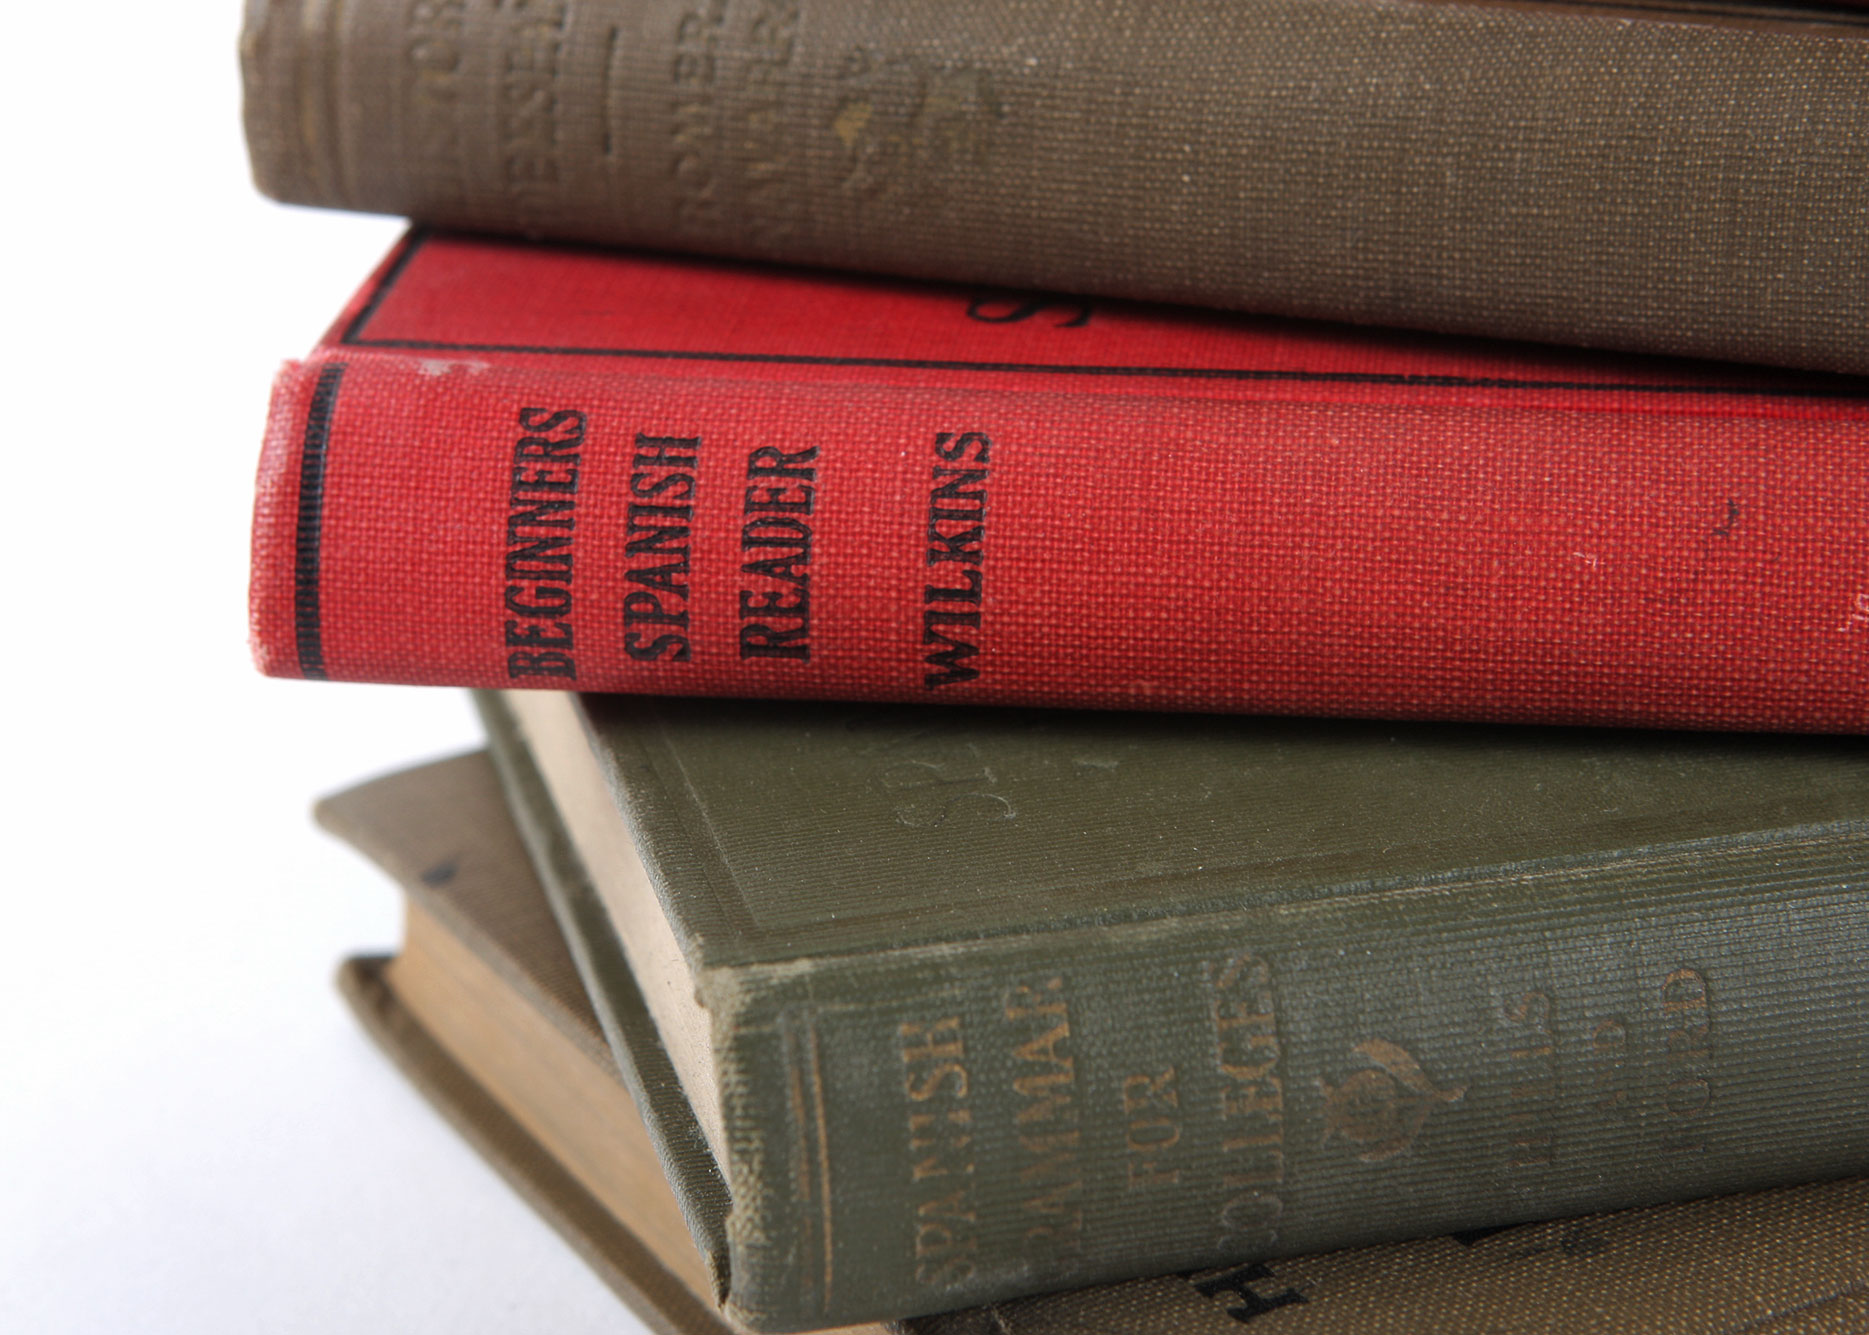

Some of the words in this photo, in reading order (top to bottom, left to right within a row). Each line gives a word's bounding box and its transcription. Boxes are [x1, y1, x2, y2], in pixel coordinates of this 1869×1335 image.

[504, 407, 587, 681] BEGINNERS
[623, 432, 701, 663] SPANISH
[738, 445, 820, 664] READER
[924, 431, 992, 690] WILKINS
[899, 1016, 978, 1288] SPANISH
[1123, 1065, 1181, 1190] FOR
